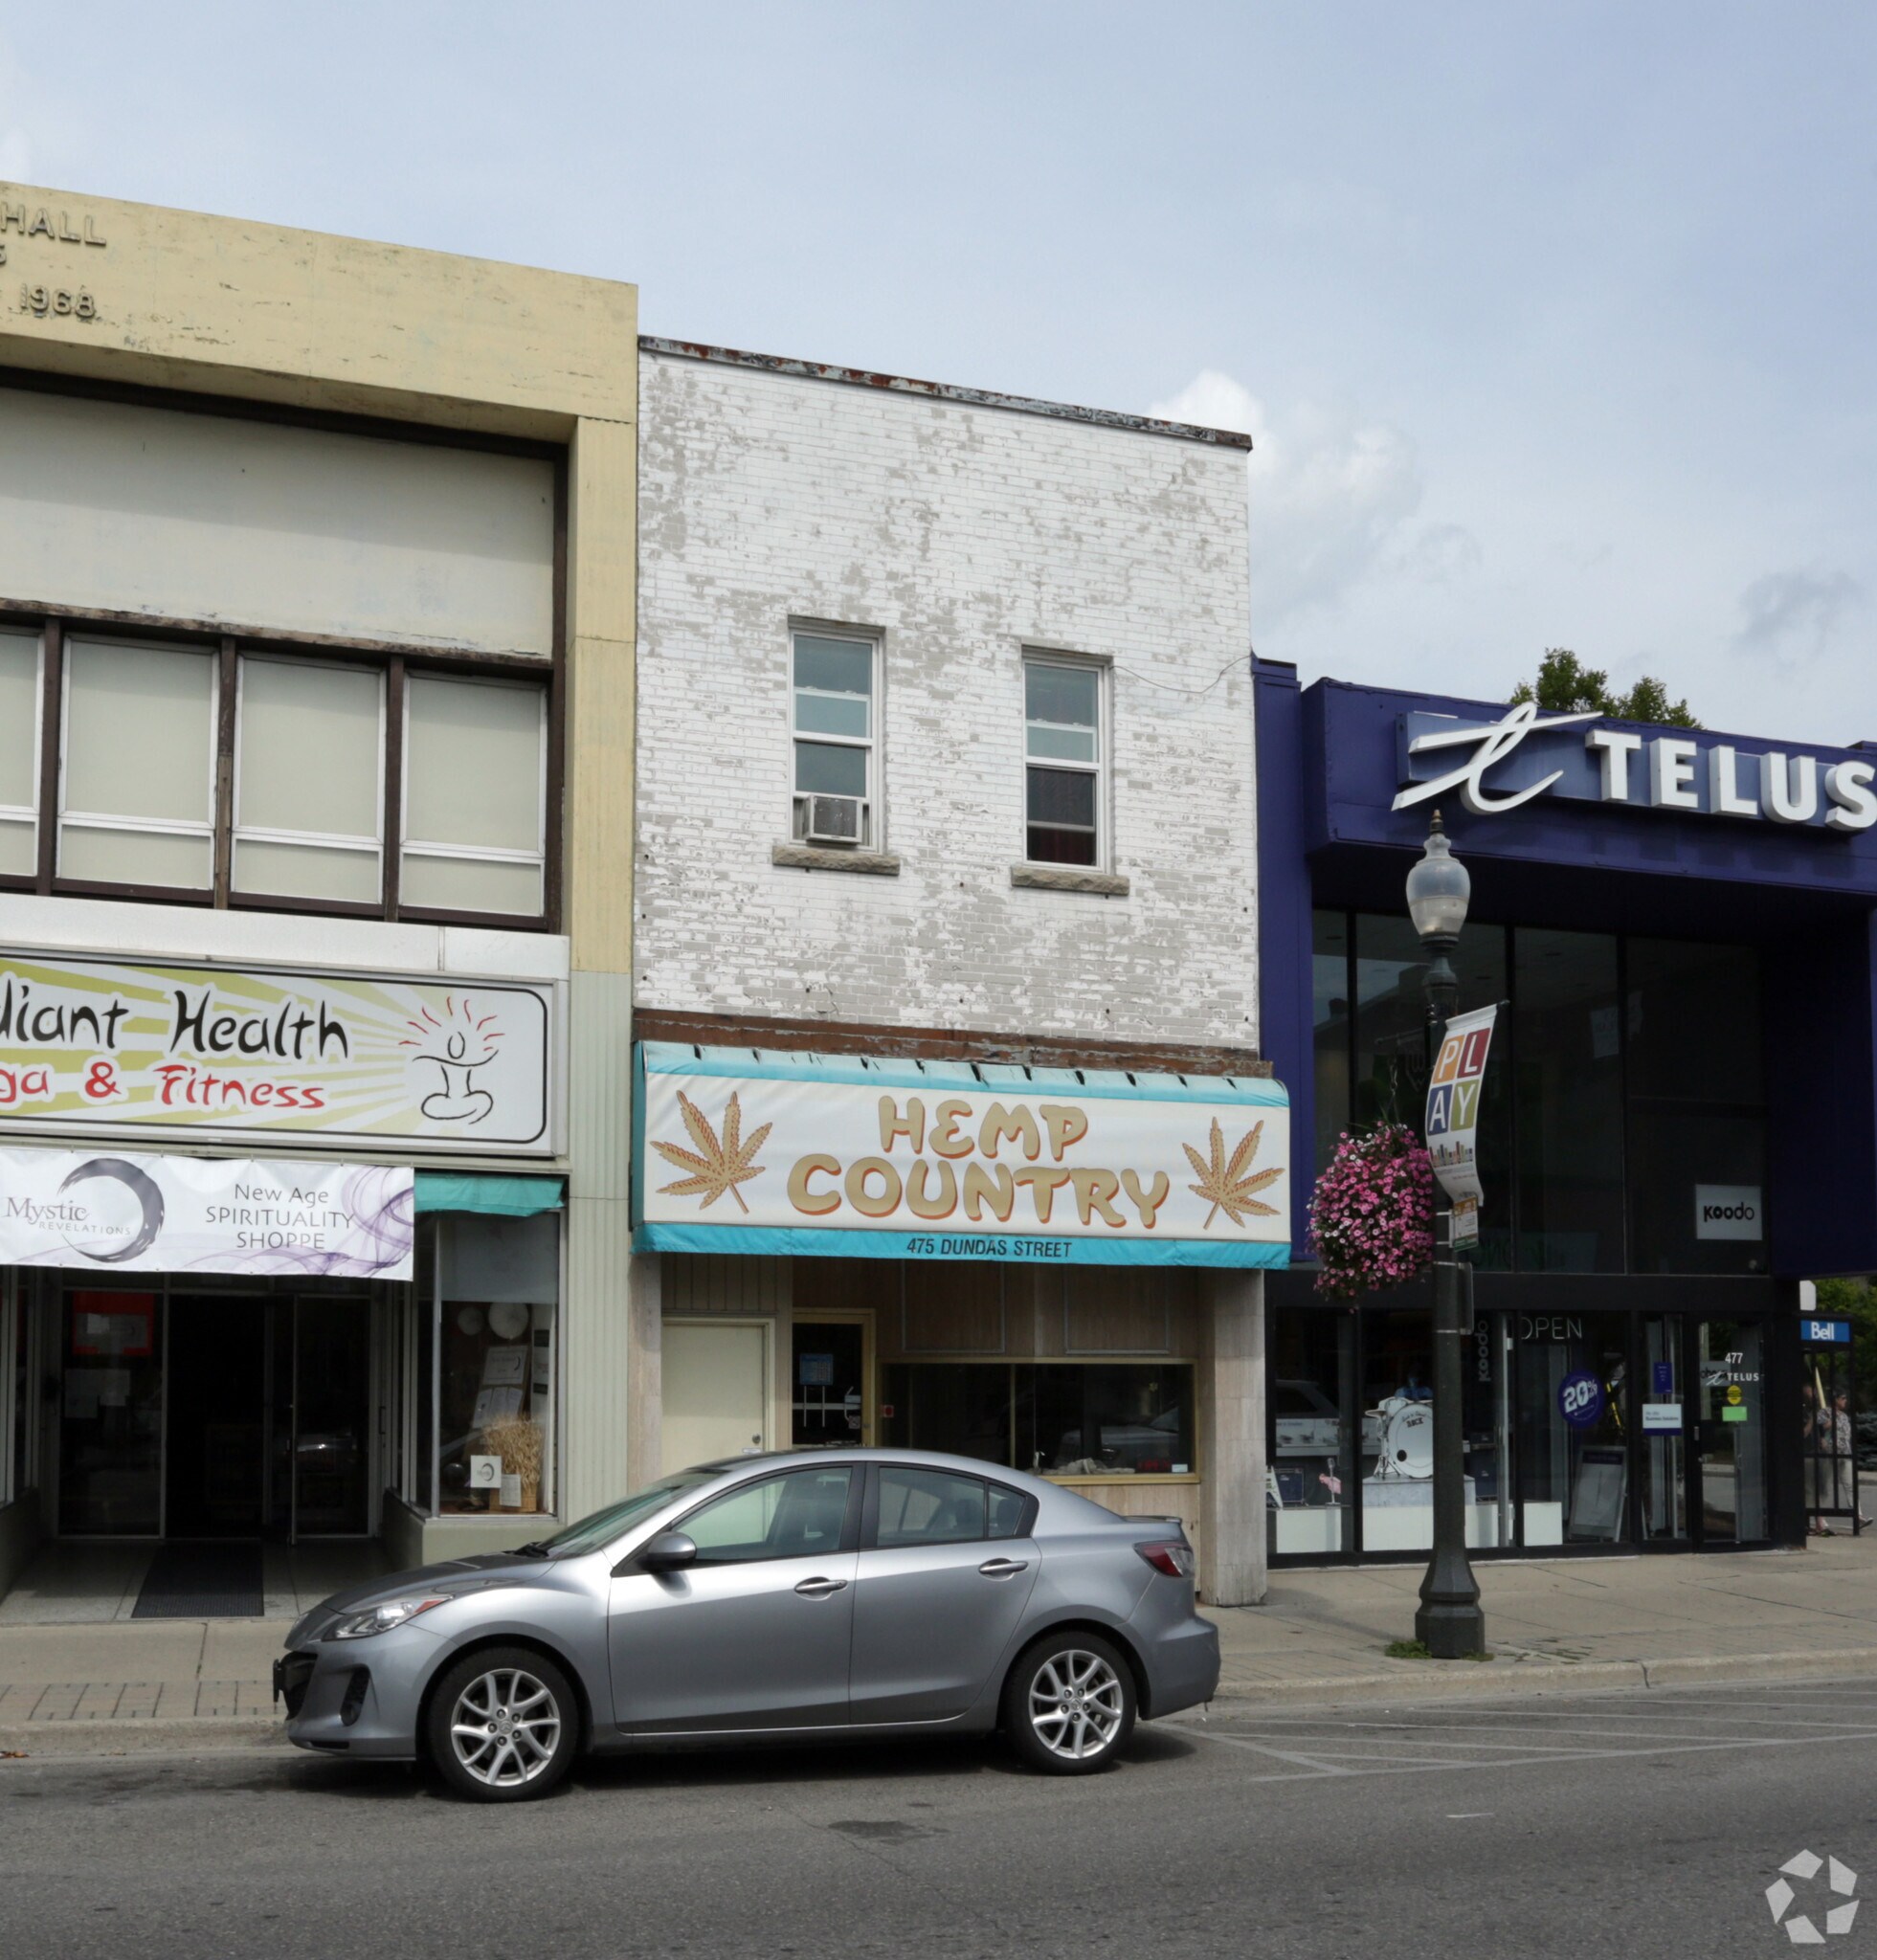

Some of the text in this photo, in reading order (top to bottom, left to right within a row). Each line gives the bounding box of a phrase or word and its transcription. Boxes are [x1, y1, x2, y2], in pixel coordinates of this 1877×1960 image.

[0, 201, 107, 247] HALL
[20, 283, 97, 319] 1968
[1584, 728, 1877, 832] TELUS
[169, 990, 348, 1059] Health
[84, 1061, 123, 1099] &
[153, 1064, 325, 1109] Fitness
[878, 1095, 1088, 1162] HEMP
[235, 1183, 329, 1209] New Age
[787, 1153, 1171, 1230] COUNTRY
[2, 1196, 90, 1225] Mystic
[205, 1206, 355, 1229] SPIRITUALITY
[1704, 1201, 1755, 1223] koodo
[38, 1221, 131, 1236] REVELATIONS
[236, 1231, 325, 1250] SHOPPE
[906, 1238, 1073, 1258] 475 DUNDAS STREET
[1810, 1321, 1835, 1340] Bell
[1474, 1320, 1491, 1382] koodo
[1725, 1352, 1743, 1364] 477
[1727, 1372, 1759, 1382] TELUS
